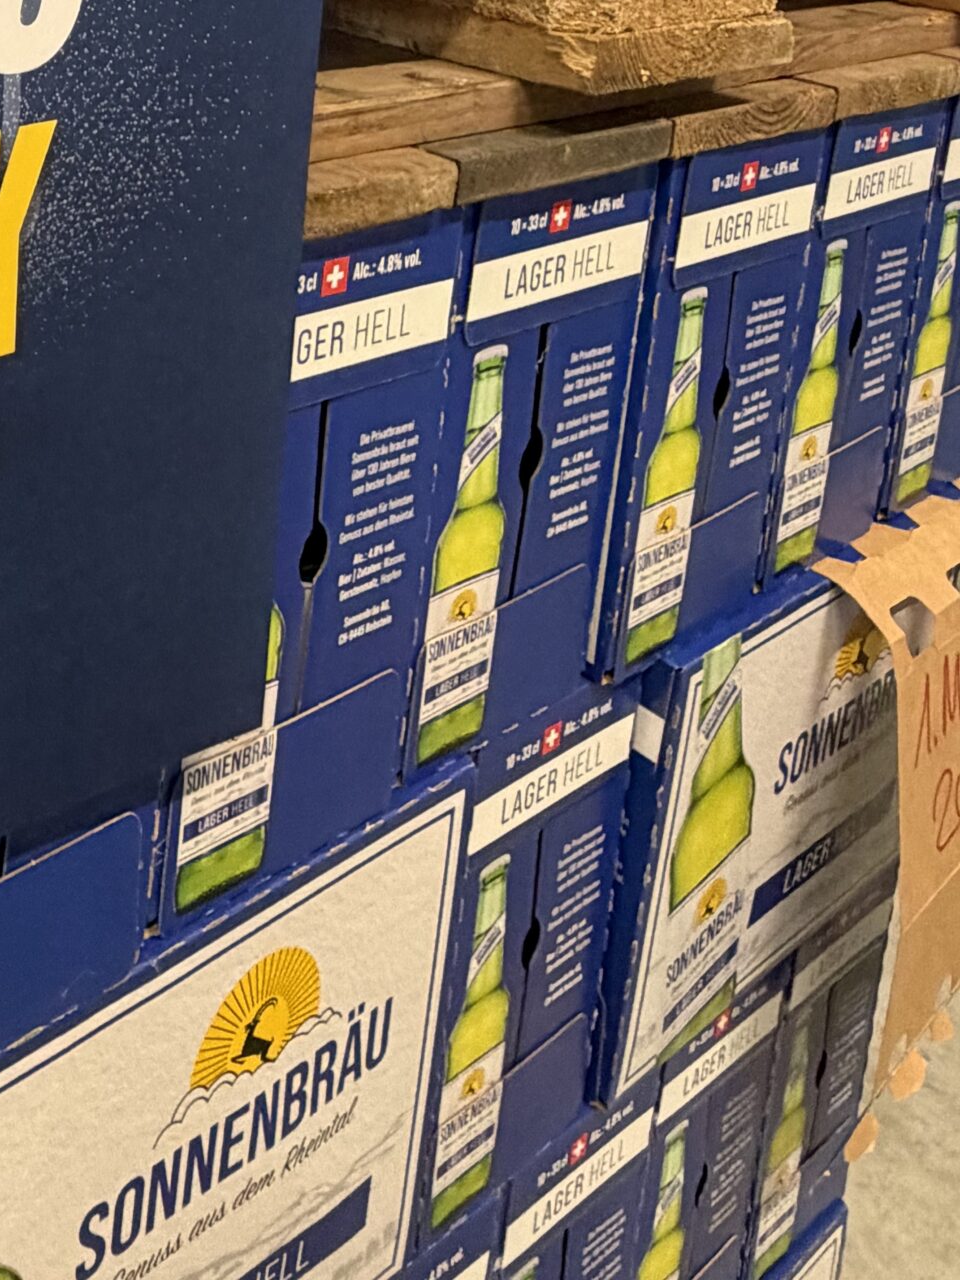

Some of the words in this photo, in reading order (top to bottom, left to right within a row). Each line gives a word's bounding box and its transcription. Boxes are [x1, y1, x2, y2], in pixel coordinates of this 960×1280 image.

[846, 180, 884, 204] LAGER
[888, 162, 913, 190] HELL
[704, 211, 752, 250] LAGER
[756, 201, 789, 235] HELL
[297, 275, 305, 294] 3
[307, 272, 317, 292] cl
[353, 261, 376, 280] Alc.:
[378, 253, 402, 274] 4.8%
[405, 248, 422, 268] vol.
[504, 254, 566, 299] LAGER
[572, 242, 614, 280] HELL
[297, 320, 345, 364] GER
[354, 304, 410, 350] HELL
[774, 668, 897, 794] SONNENBR
[501, 768, 558, 825] LAGER
[563, 742, 603, 787] HELL
[198, 807, 229, 832] LAGER
[231, 794, 256, 816] HELL
[782, 836, 831, 894] LAGER
[682, 1045, 726, 1097] LAGER
[74, 996, 395, 1280] SONNENBRÄU
[112, 1231, 182, 1280] Genuss
[188, 1201, 227, 1243] aus
[237, 1175, 277, 1212] dem
[280, 1096, 359, 1179] Rheintal
[532, 1174, 584, 1234] LAGER
[589, 1139, 623, 1186] HELL
